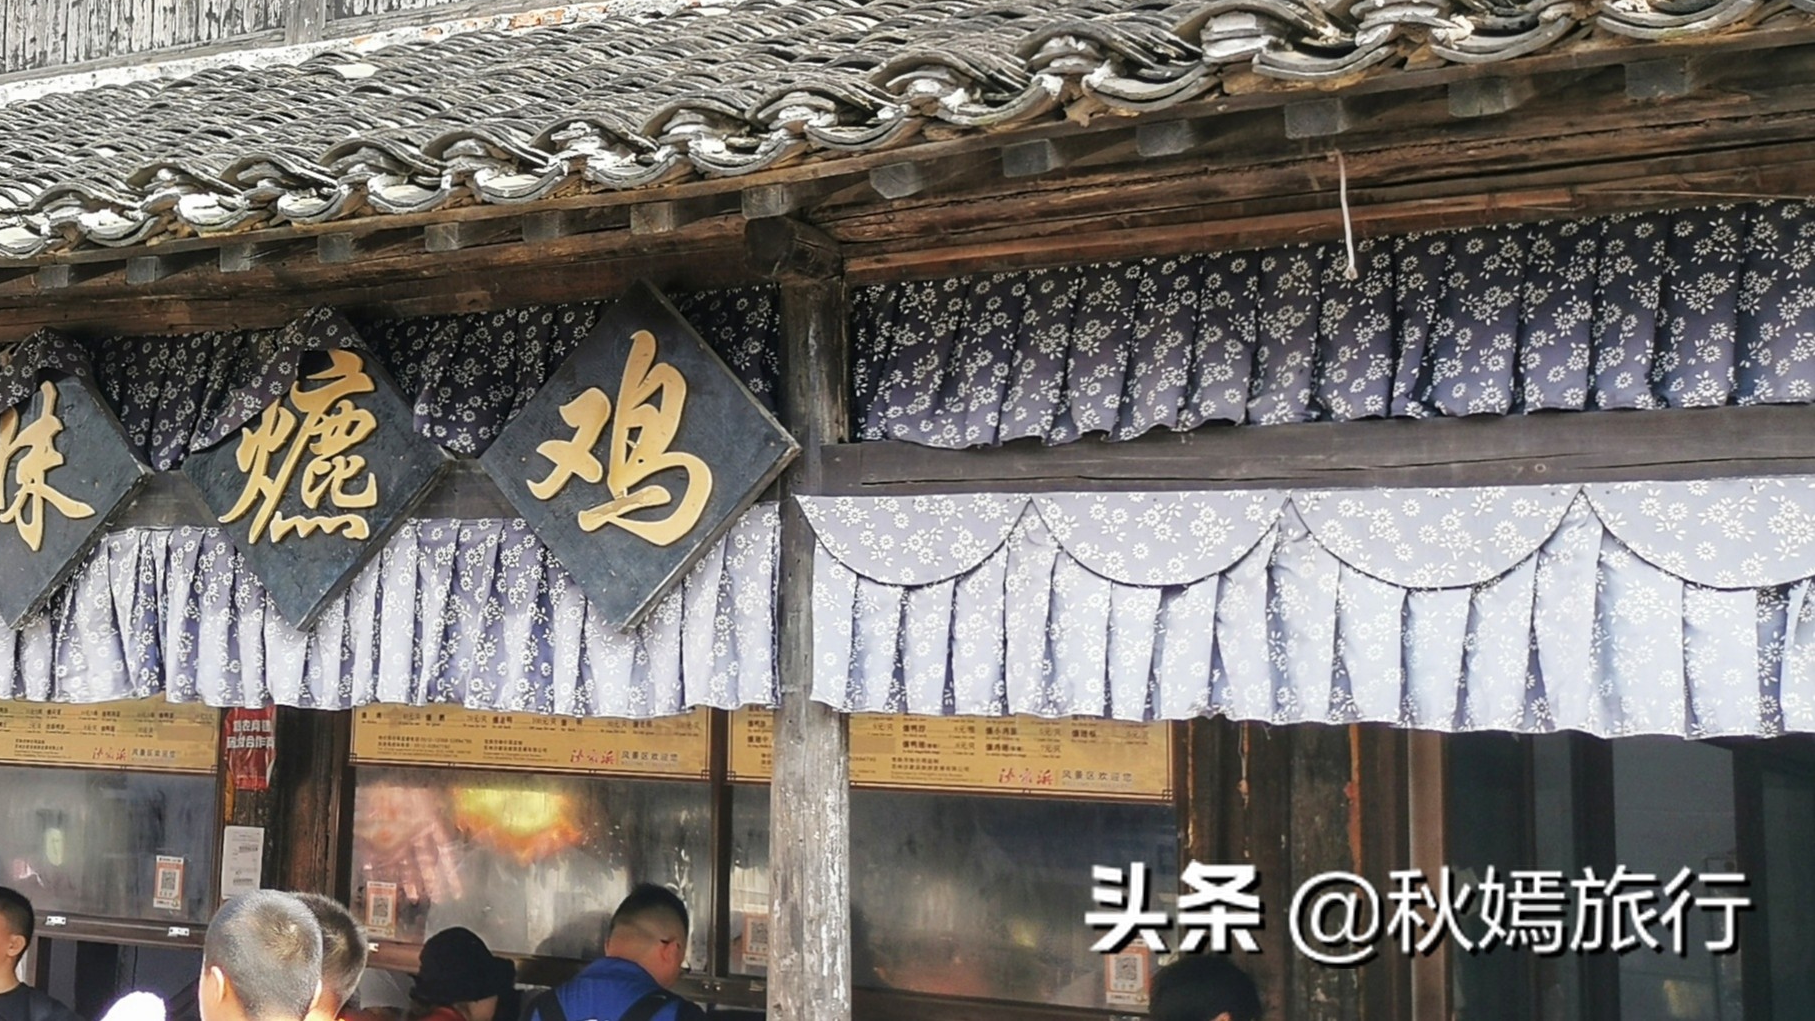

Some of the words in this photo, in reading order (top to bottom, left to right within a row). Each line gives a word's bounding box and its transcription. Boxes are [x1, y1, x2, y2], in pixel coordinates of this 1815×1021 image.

[1062, 769, 1133, 783] 风景区欢迎您
